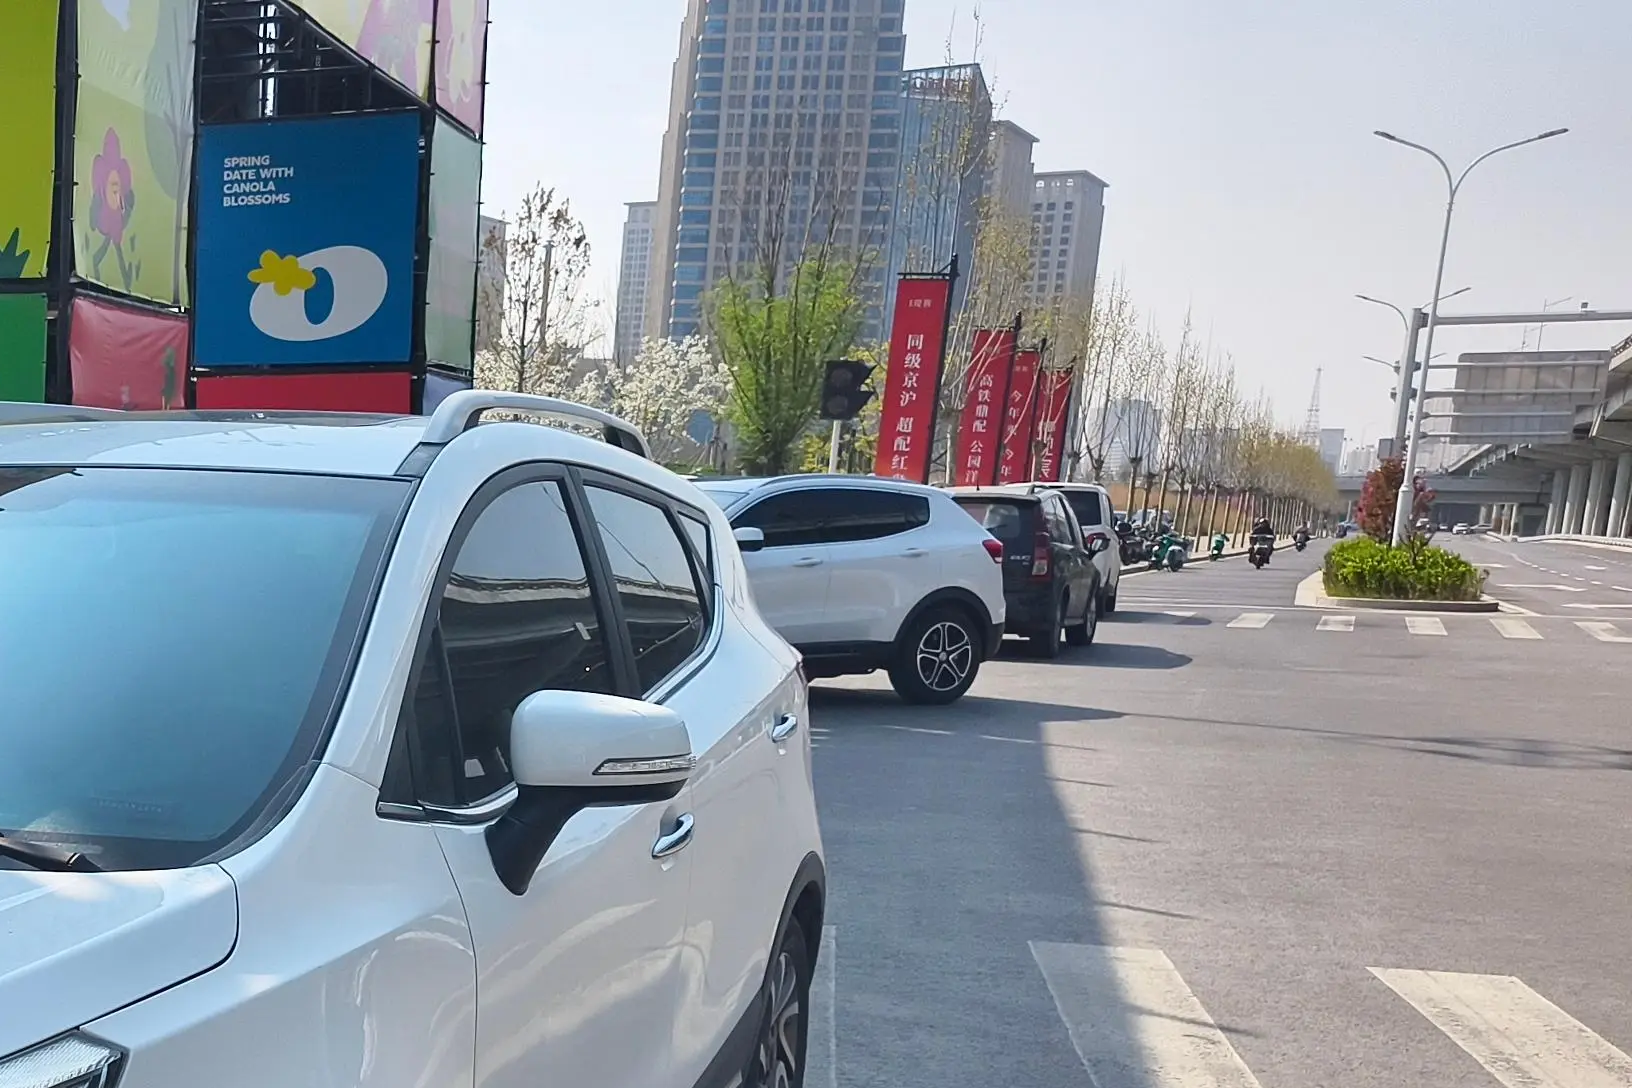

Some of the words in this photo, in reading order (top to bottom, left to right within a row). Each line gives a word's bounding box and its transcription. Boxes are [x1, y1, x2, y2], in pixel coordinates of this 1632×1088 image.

[223, 155, 270, 168] SPRING
[223, 169, 257, 181] DATE
[259, 166, 295, 179] WITH
[223, 180, 276, 194] CANOLA
[223, 193, 292, 207] BLOSSOMS
[900, 334, 924, 407] 同级京沪
